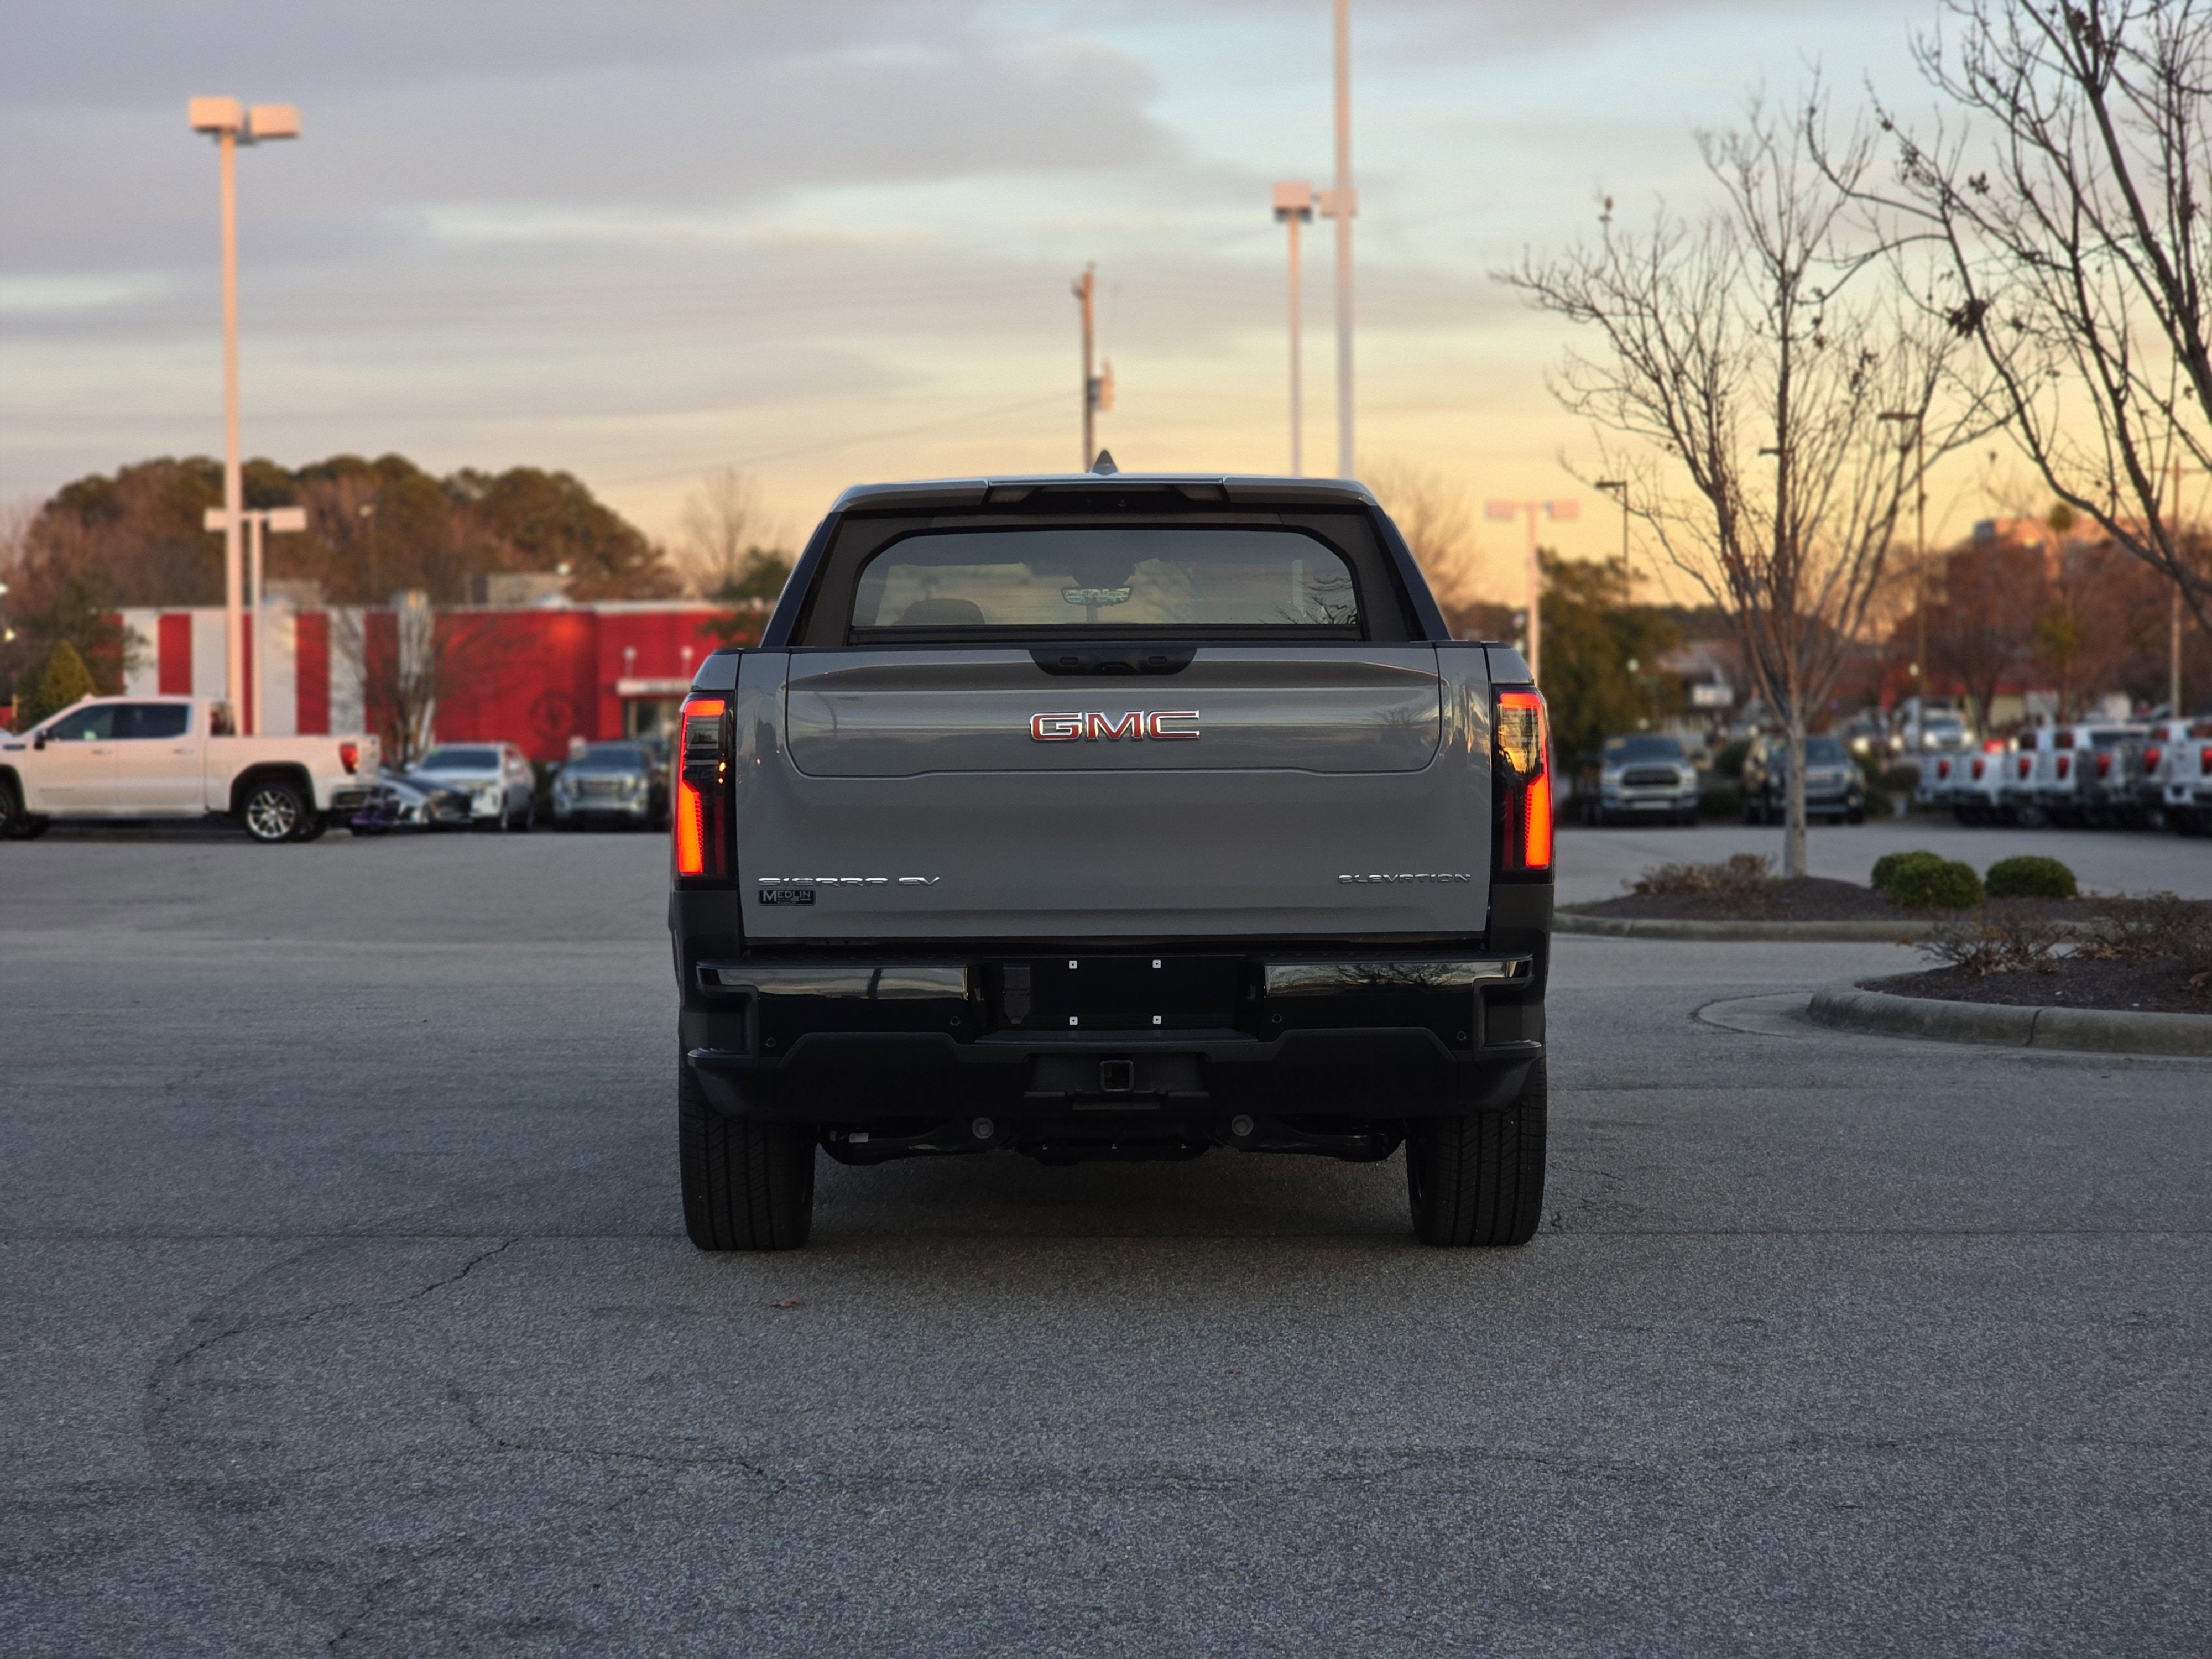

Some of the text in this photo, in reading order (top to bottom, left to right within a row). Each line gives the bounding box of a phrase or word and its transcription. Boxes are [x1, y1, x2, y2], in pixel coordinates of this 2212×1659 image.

[1030, 711, 1199, 740] GMC
[758, 877, 940, 887] SIERRA EV
[1338, 874, 1471, 883] ELEVATION
[763, 890, 811, 902] MEDLIN
